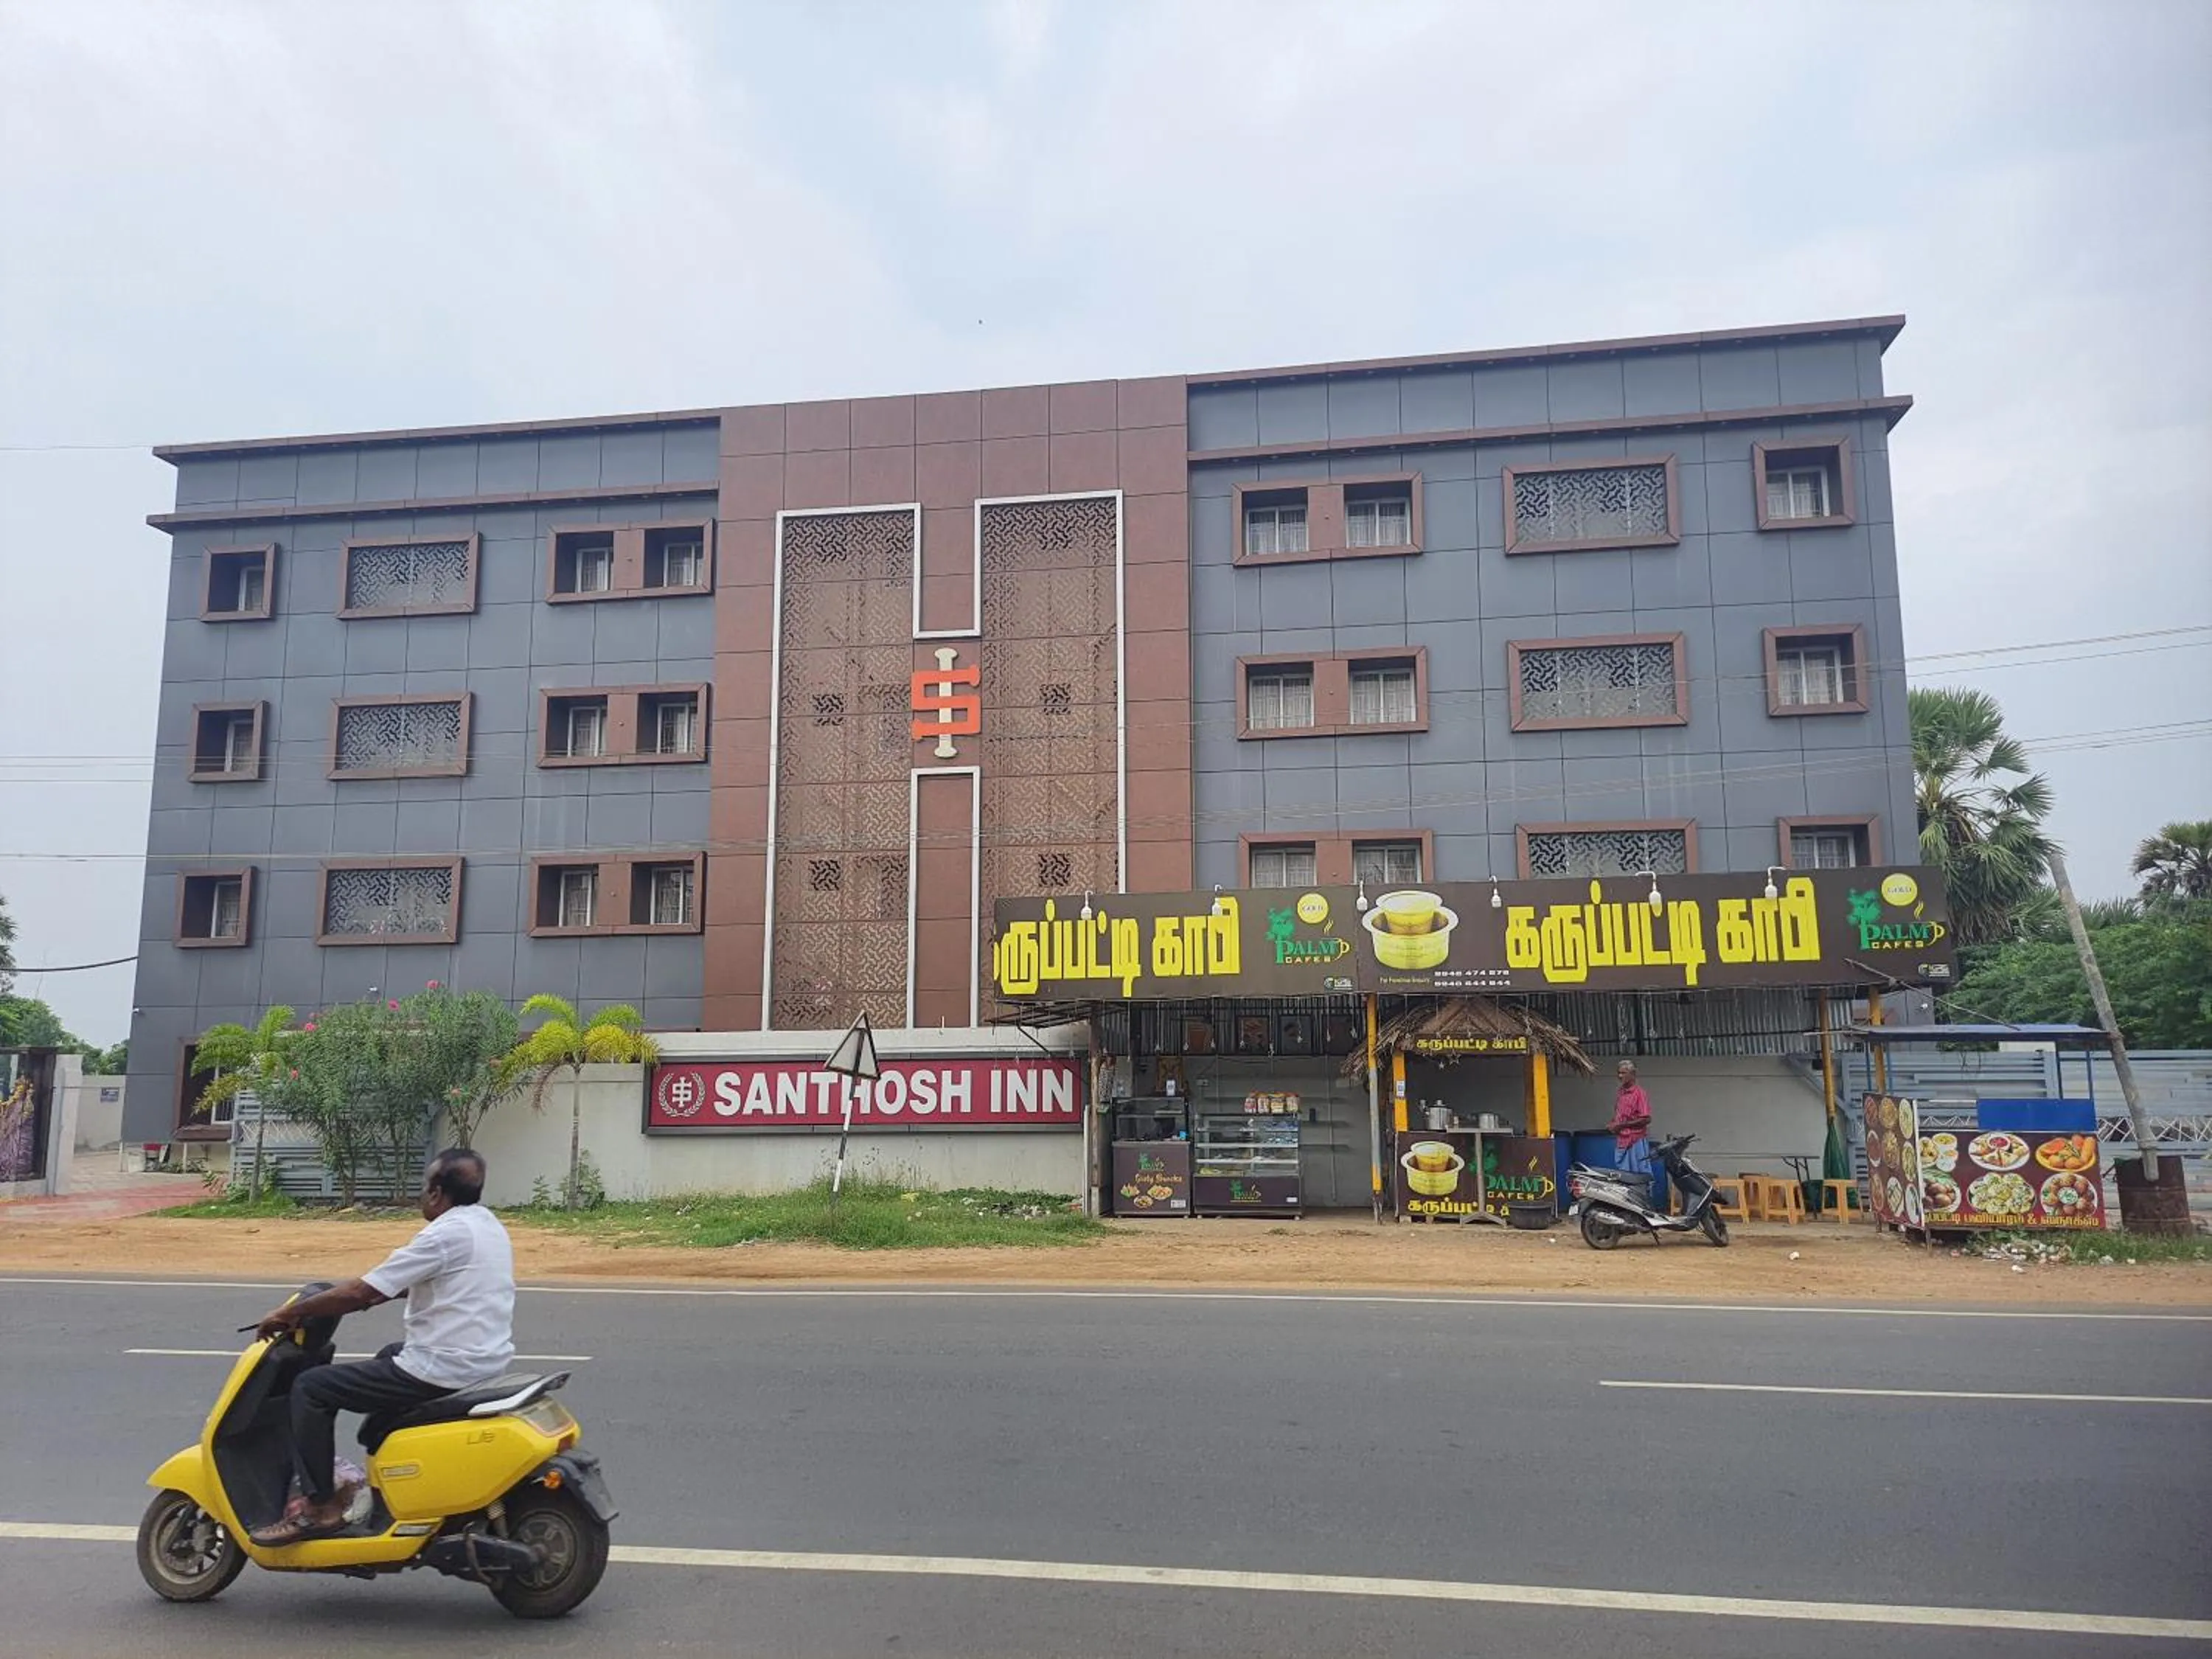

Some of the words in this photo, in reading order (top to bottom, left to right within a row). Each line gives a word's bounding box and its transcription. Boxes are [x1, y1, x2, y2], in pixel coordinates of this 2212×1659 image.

[1152, 897, 1239, 977] காபி
[1505, 880, 1705, 986] கருப்பட்டி
[1717, 877, 1820, 962] காபி
[713, 1069, 972, 1116] SANTHOSH
[990, 1068, 1073, 1113] INN
